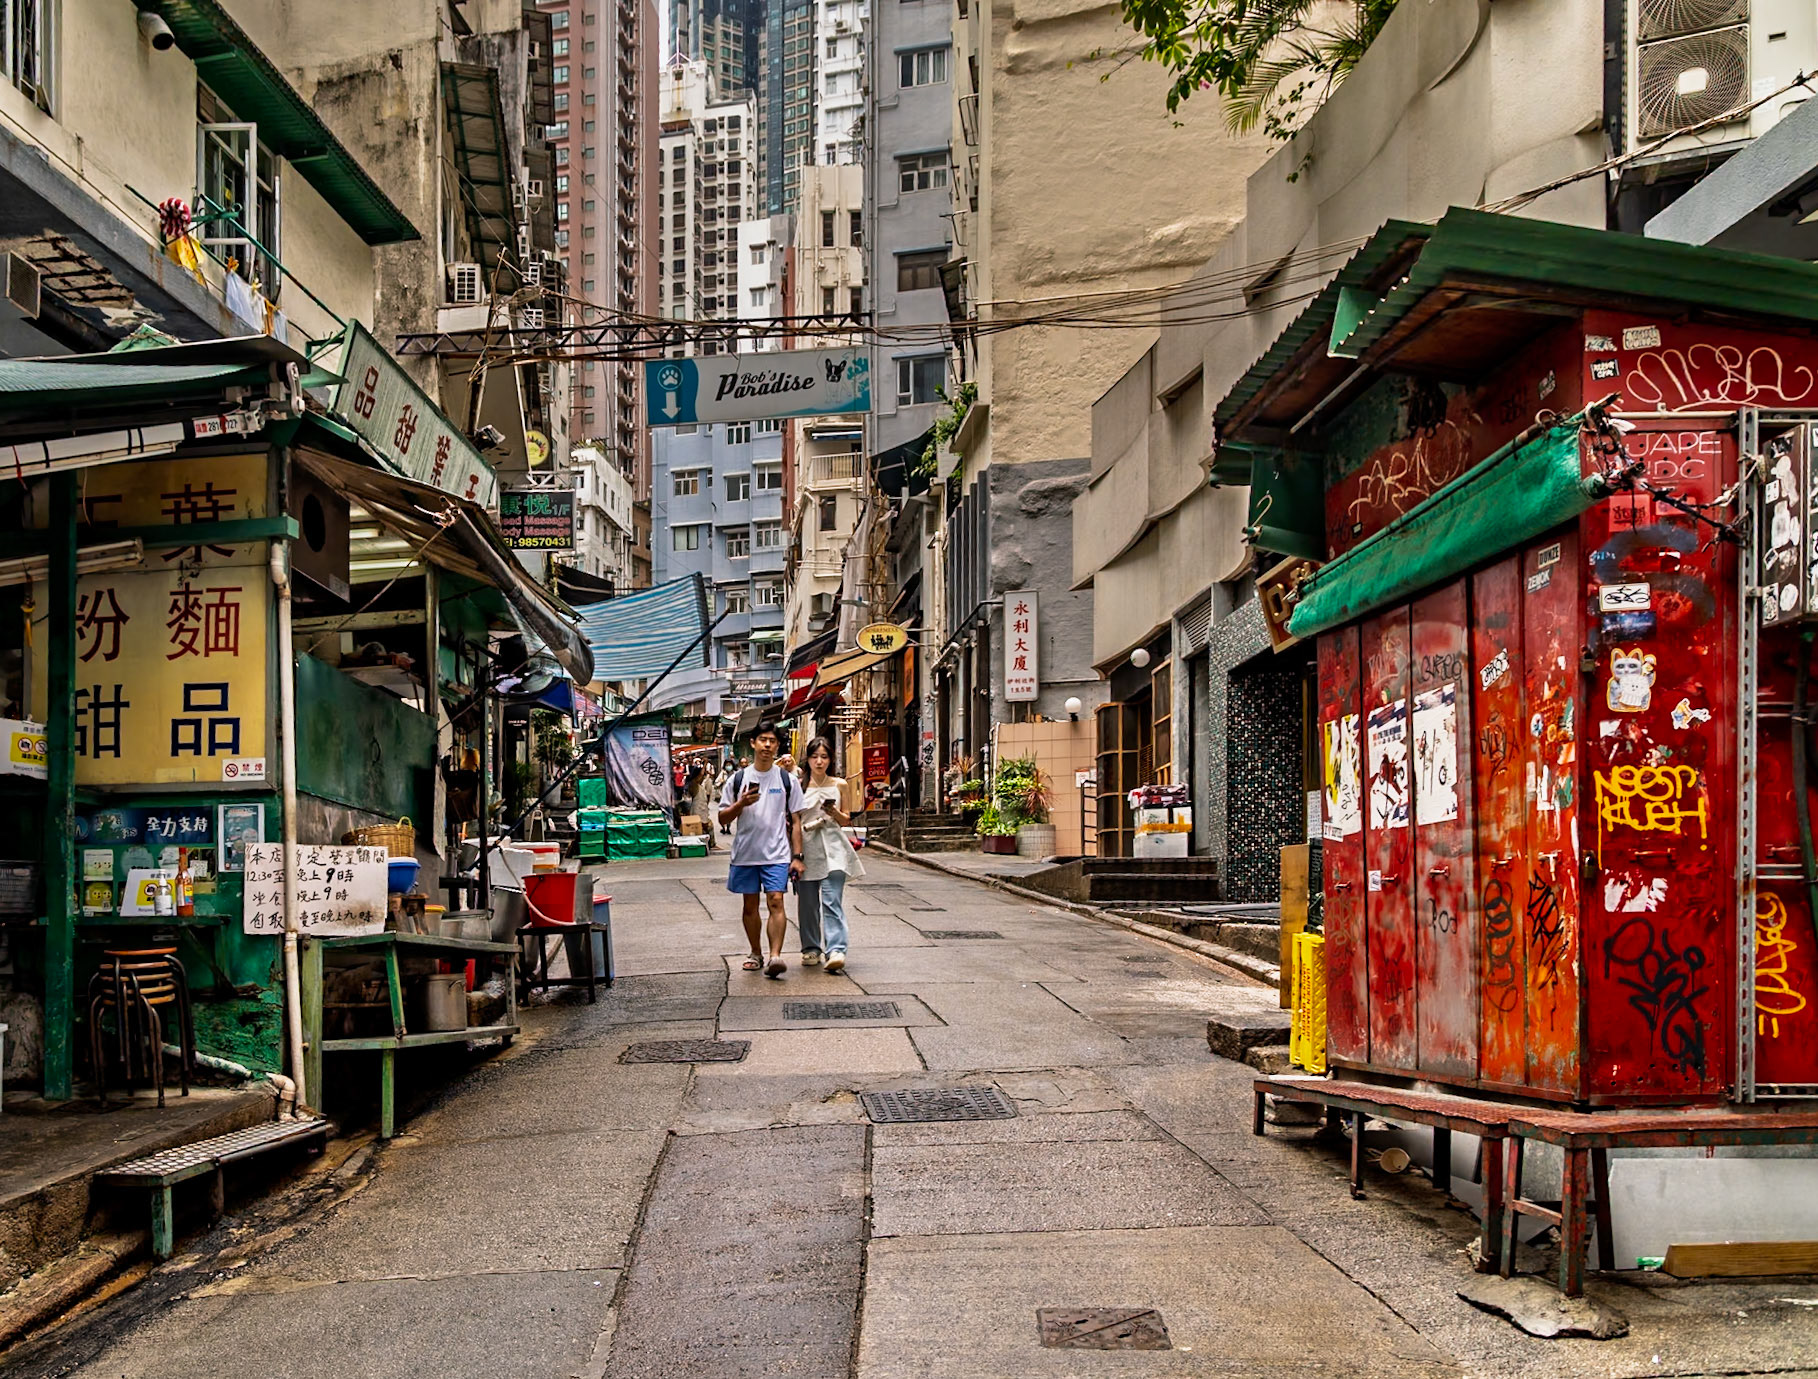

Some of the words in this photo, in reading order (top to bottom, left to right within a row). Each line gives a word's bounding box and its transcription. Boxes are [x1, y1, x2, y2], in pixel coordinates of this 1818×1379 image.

[714, 372, 816, 402] Paradise
[740, 369, 778, 386] Bob's
[502, 516, 522, 526] ead
[502, 527, 522, 538] ody
[75, 582, 243, 663] 粉麵
[1012, 600, 1030, 671] 永利大廈
[147, 817, 208, 837] 全力支持
